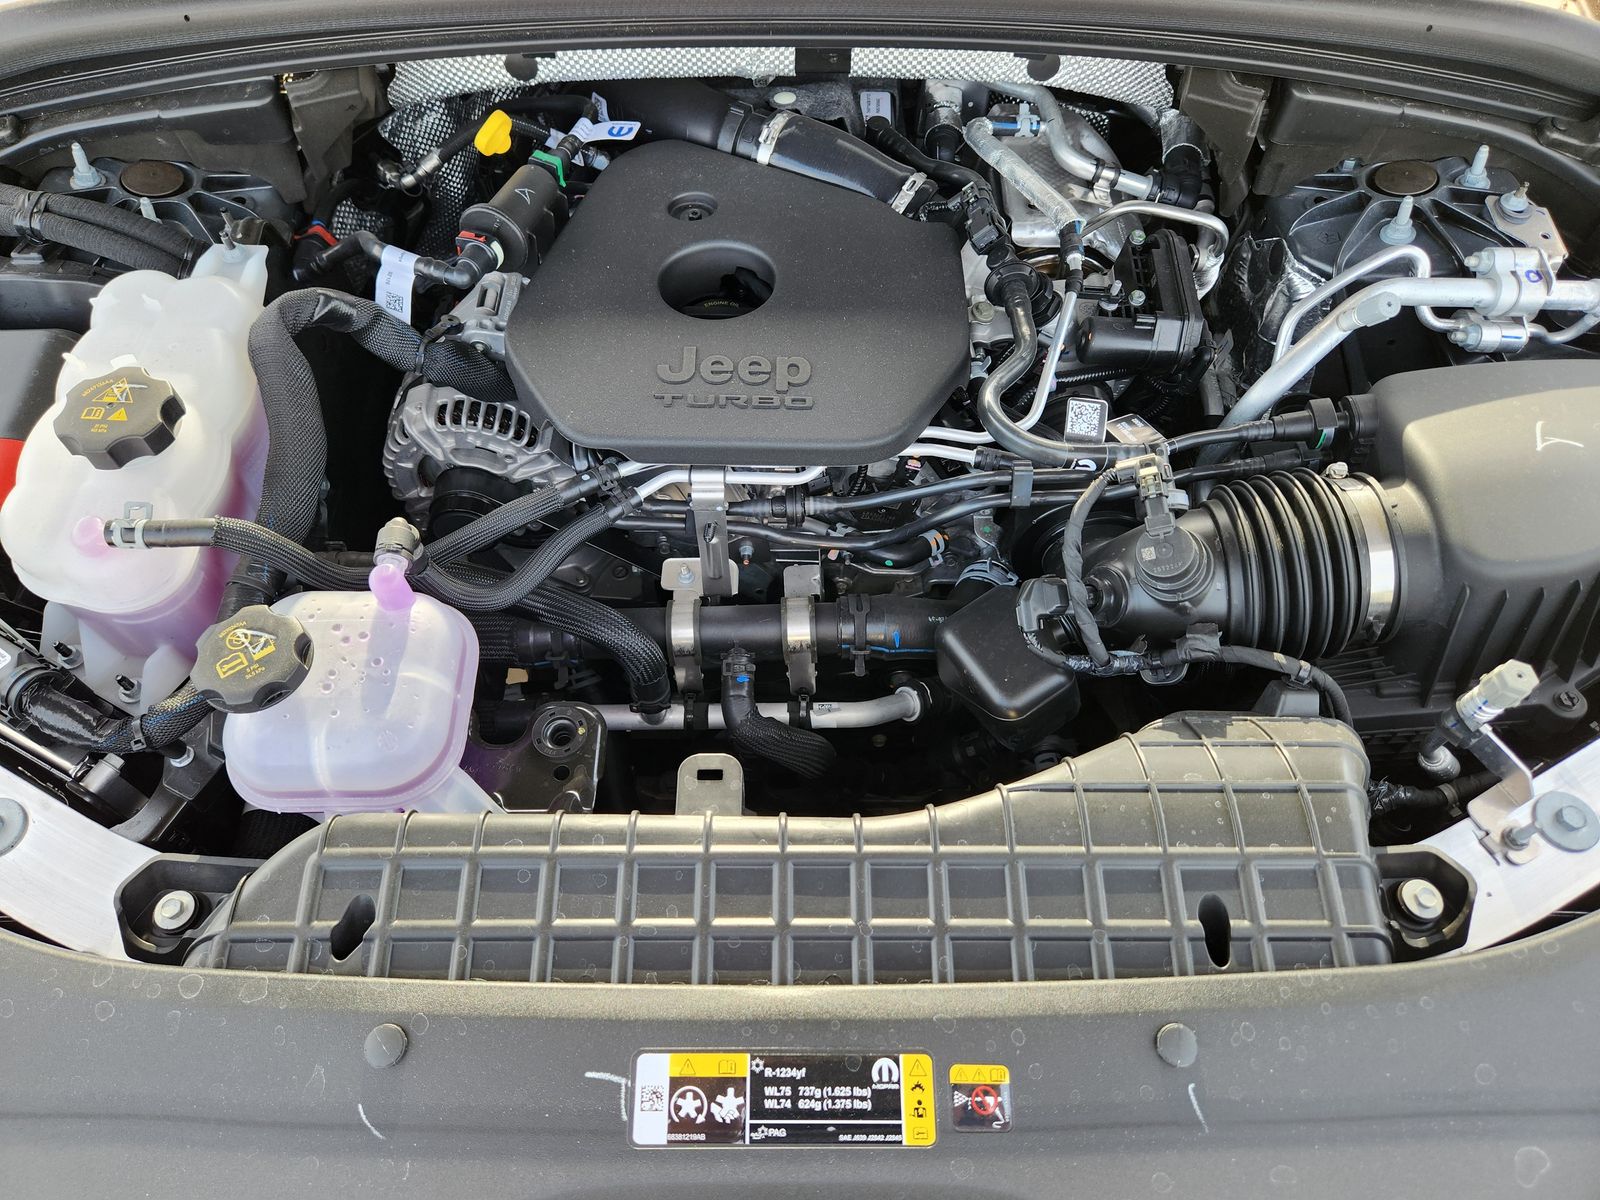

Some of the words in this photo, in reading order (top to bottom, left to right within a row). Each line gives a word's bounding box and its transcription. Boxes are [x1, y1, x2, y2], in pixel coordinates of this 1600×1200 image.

[656, 346, 812, 394] Jeep
[653, 393, 815, 410] TURBO
[764, 1067, 806, 1079] R-1234yf
[764, 1086, 792, 1097] WL75
[798, 1086, 822, 1098] 737g
[823, 1086, 852, 1098] (1.625
[853, 1086, 872, 1098] lbs)
[764, 1099, 792, 1109] WL74
[798, 1099, 822, 1110] 624g
[823, 1099, 852, 1110] (1.375
[853, 1099, 872, 1110] lbs)
[768, 1128, 787, 1137] PAG
